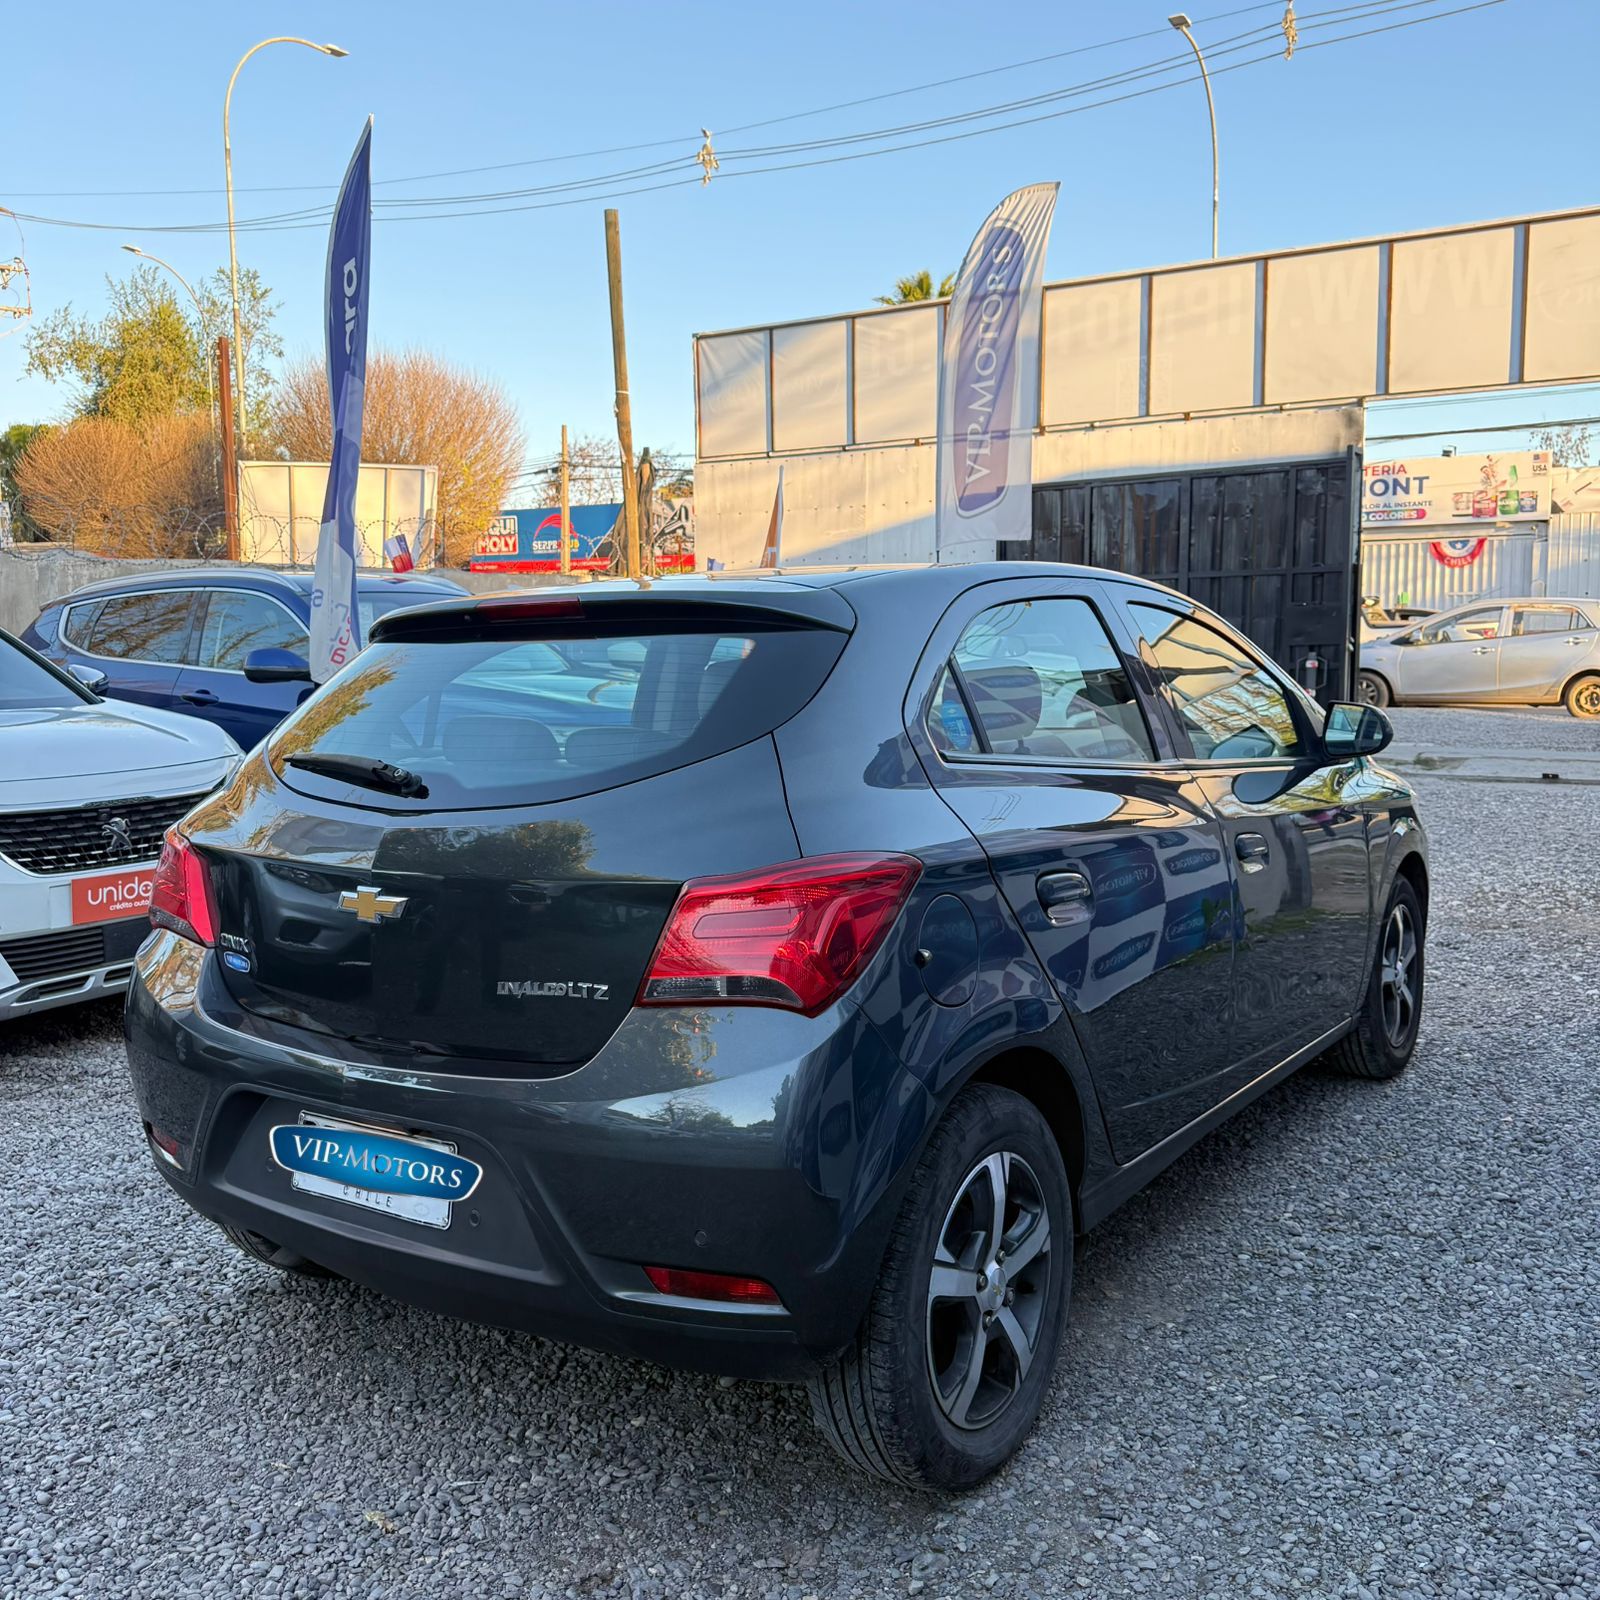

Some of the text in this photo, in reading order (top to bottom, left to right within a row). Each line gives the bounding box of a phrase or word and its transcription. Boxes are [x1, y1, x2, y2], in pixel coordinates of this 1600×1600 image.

[1394, 500, 1433, 508] INSTANTE
[1369, 511, 1418, 521] COLORES
[477, 536, 516, 553] MOLY
[133, 899, 151, 907] auto
[220, 933, 249, 953] ONIX
[342, 1184, 393, 1208] CHILE
